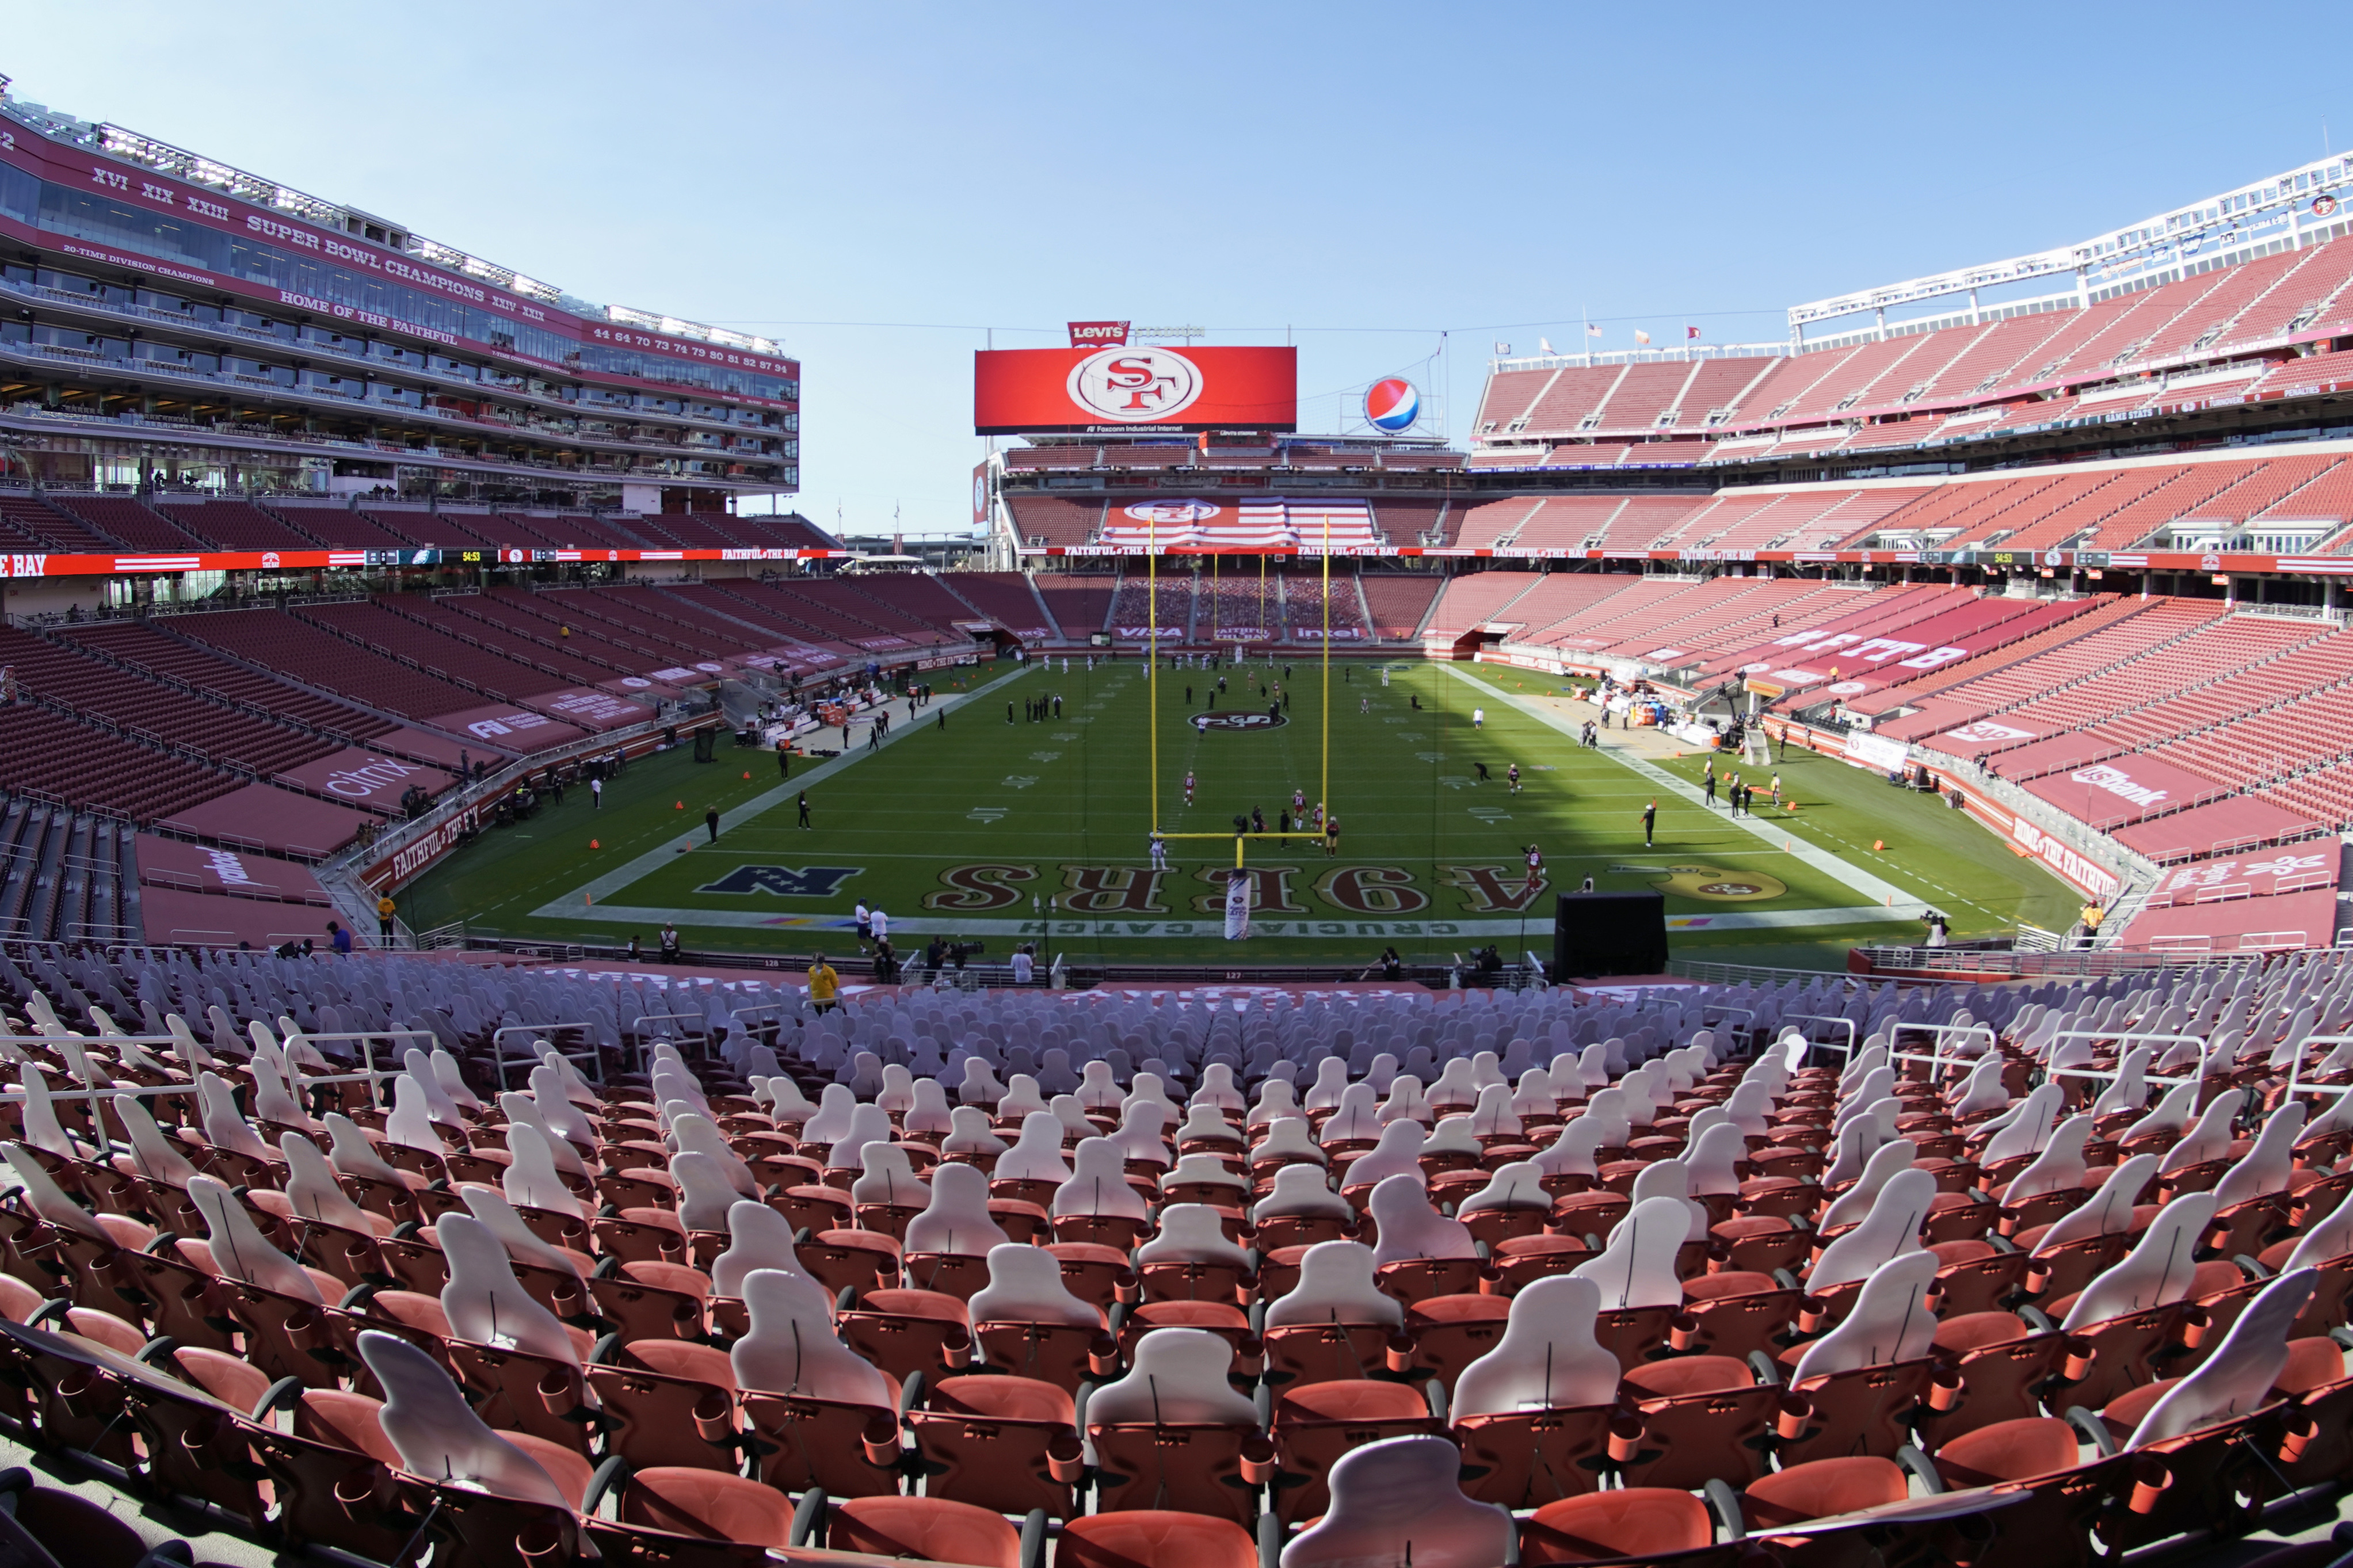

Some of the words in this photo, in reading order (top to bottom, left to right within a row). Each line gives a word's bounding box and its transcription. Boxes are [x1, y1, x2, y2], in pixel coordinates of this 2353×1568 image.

[93, 167, 128, 190] XVI
[142, 182, 174, 205] XIX
[187, 197, 229, 222] XXIII
[247, 215, 319, 250] SUPER
[325, 239, 381, 270] BOWL
[385, 260, 485, 302] CHAMPIONS
[492, 295, 516, 312] XXIV
[523, 304, 544, 322] XXIX
[63, 245, 106, 261] 20-TIME
[109, 255, 156, 272] DIVISION
[158, 266, 215, 285] CHAMPIONS
[281, 291, 329, 313] HOME
[334, 305, 354, 318] OF
[358, 311, 387, 328] THE
[392, 320, 457, 345] FAITHFUL
[1135, 326, 1205, 337] STADIUM
[594, 329, 610, 339] 44
[615, 332, 631, 343] 64
[636, 336, 650, 346] 70
[655, 339, 669, 350] 73
[674, 343, 688, 354] 74
[692, 347, 705, 357] 79
[710, 350, 724, 361] 80
[728, 354, 739, 364] 81
[743, 357, 756, 367] 82
[760, 360, 772, 371] 87
[775, 364, 787, 374] 94
[2149, 355, 2184, 369] SUPER
[2186, 349, 2218, 363] BOWL
[2218, 336, 2289, 357] CHAMPIONS
[2209, 395, 2245, 407] TURNOVERS
[2285, 386, 2320, 397] PENALTIES
[2329, 384, 2336, 392] 0
[2105, 411, 2127, 423] GAME
[2129, 409, 2153, 419] STATS
[463, 552, 480, 562] 54:53
[722, 549, 762, 559] FAITHFUL
[767, 549, 783, 559] THE
[784, 549, 799, 559] BAY
[1065, 547, 1116, 555] FAITHFUL
[1122, 546, 1143, 555] THE
[1355, 547, 1377, 555] THE
[1379, 547, 1399, 556] BAY
[1492, 548, 1539, 558] FAITHFUL
[1546, 548, 1568, 558] THE
[1569, 548, 1589, 558] BAY
[1679, 550, 1717, 560] FAITHFUL
[1721, 550, 1738, 560] THE
[1738, 550, 1756, 560] BAY
[1994, 553, 2012, 564] 54:53
[12, 555, 47, 577] BAY
[1115, 627, 1183, 636] VISA
[917, 659, 933, 670] HOME
[936, 657, 947, 667] THE
[1957, 724, 2011, 739] SAP
[394, 831, 441, 880] FAITHFUL
[445, 815, 462, 845] THE
[2013, 817, 2041, 853] HOME
[2043, 836, 2065, 869] THE
[1019, 921, 1193, 934] CATCH
[1222, 922, 1459, 935] CRUCIA
